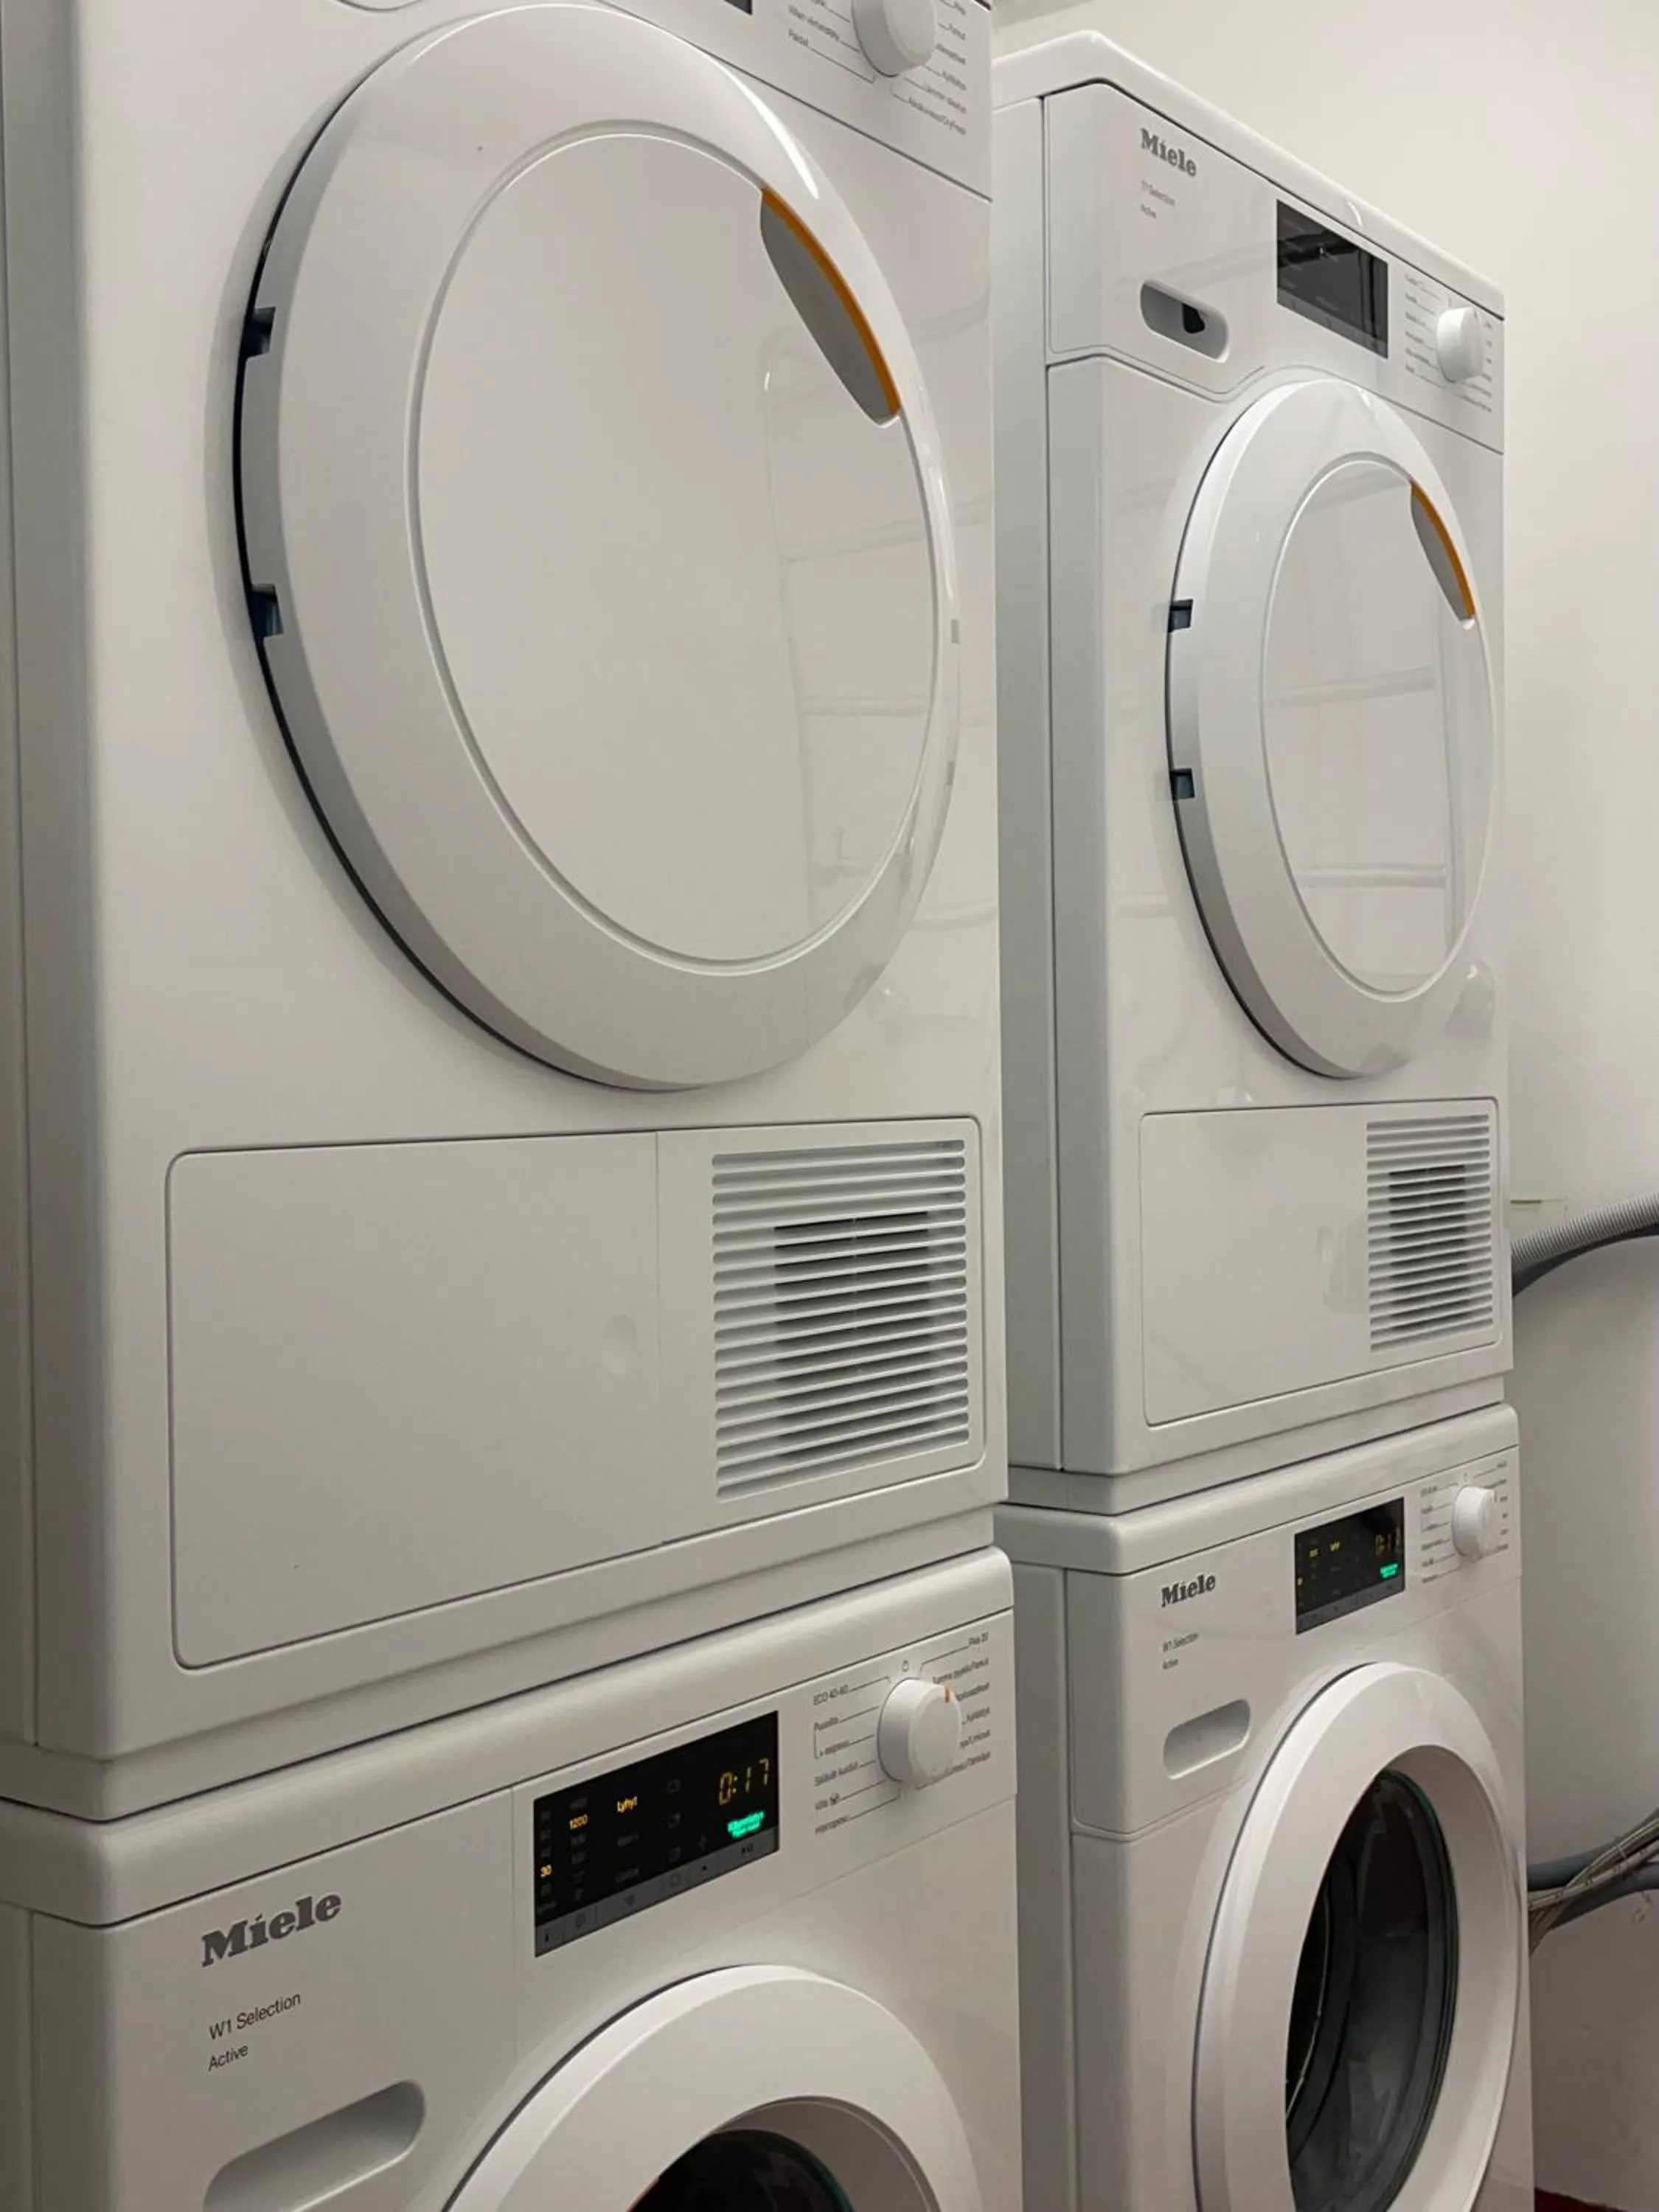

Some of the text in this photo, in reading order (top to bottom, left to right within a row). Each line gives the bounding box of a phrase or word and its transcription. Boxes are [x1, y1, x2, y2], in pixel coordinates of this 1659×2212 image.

[1140, 128, 1196, 177] Miele
[1161, 1573, 1216, 1607] Miele
[718, 1757, 769, 1806] 0:17
[569, 1814, 588, 1830] 1200
[201, 1893, 342, 1968] Miele
[208, 1992, 302, 2041] W1 Selection
[208, 2044, 248, 2072] Active
